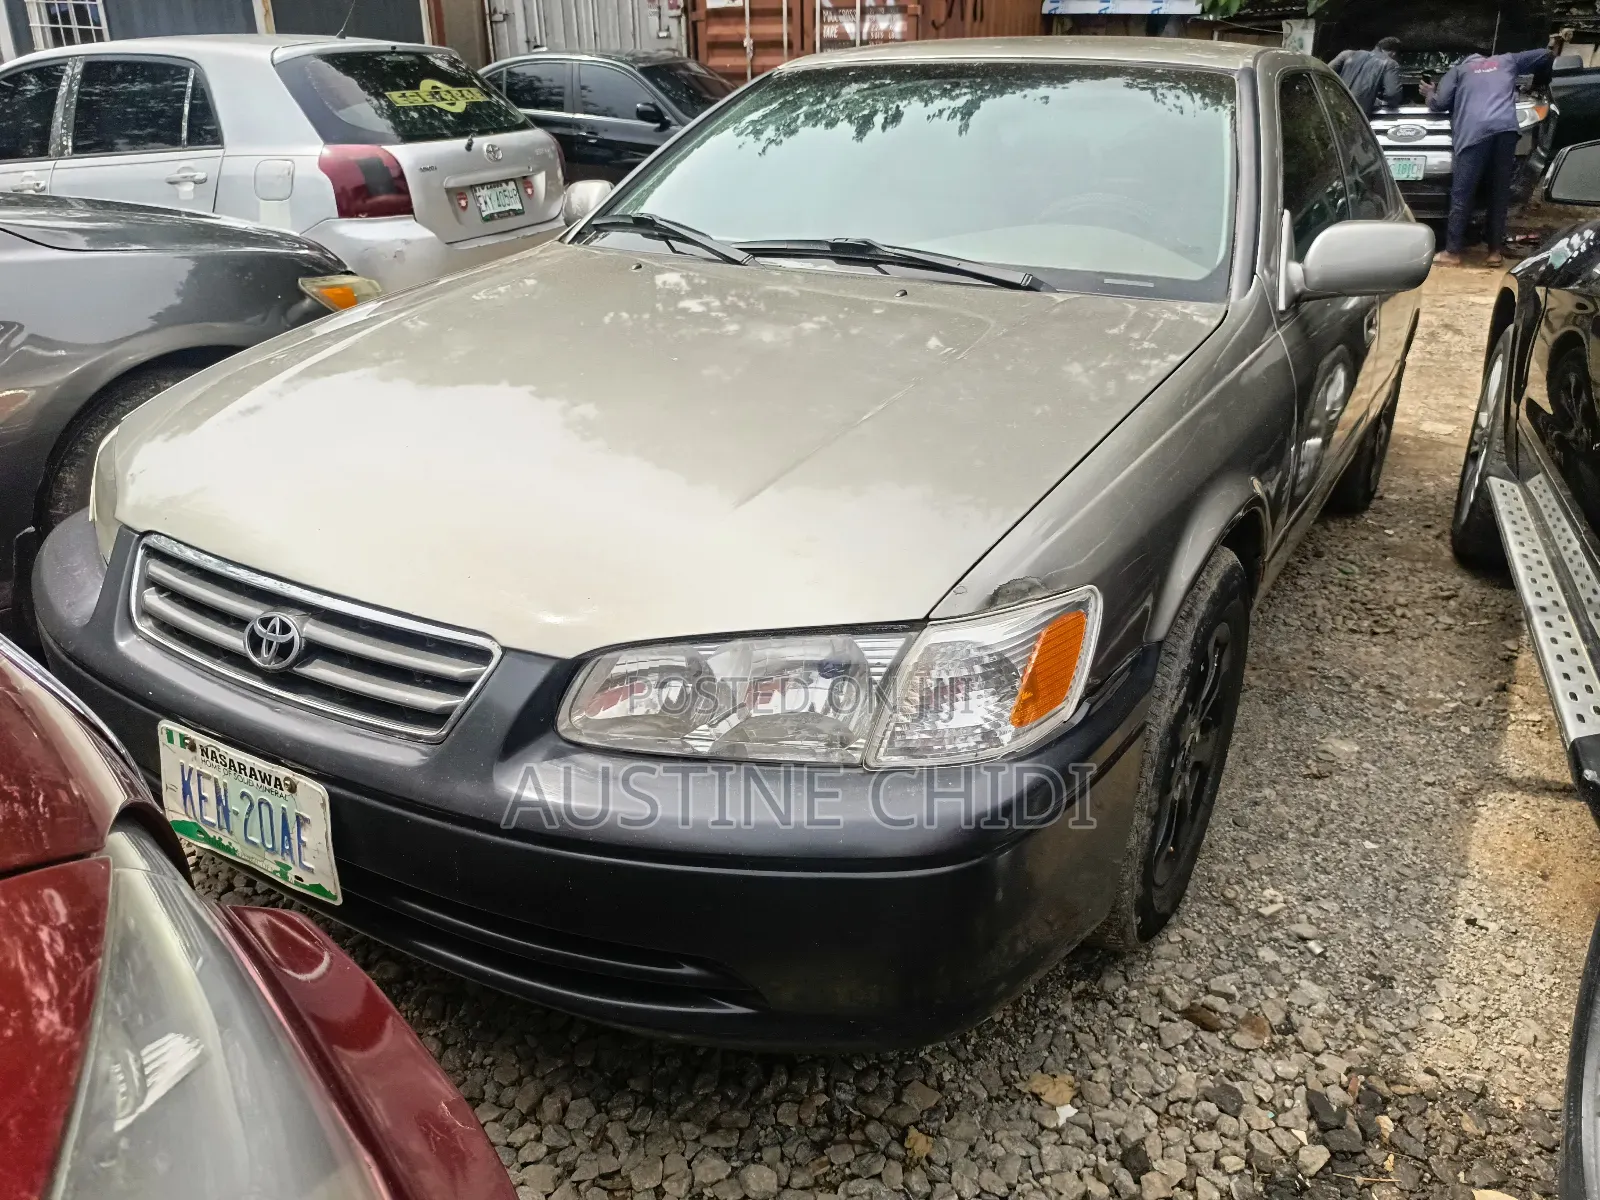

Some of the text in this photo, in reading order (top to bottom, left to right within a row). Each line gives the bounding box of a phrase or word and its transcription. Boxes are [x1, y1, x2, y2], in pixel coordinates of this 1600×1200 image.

[199, 745, 285, 791] NASARAWA
[200, 757, 289, 802] HOME OF SOLID MINERAL
[179, 761, 316, 875] KEN-20AE
